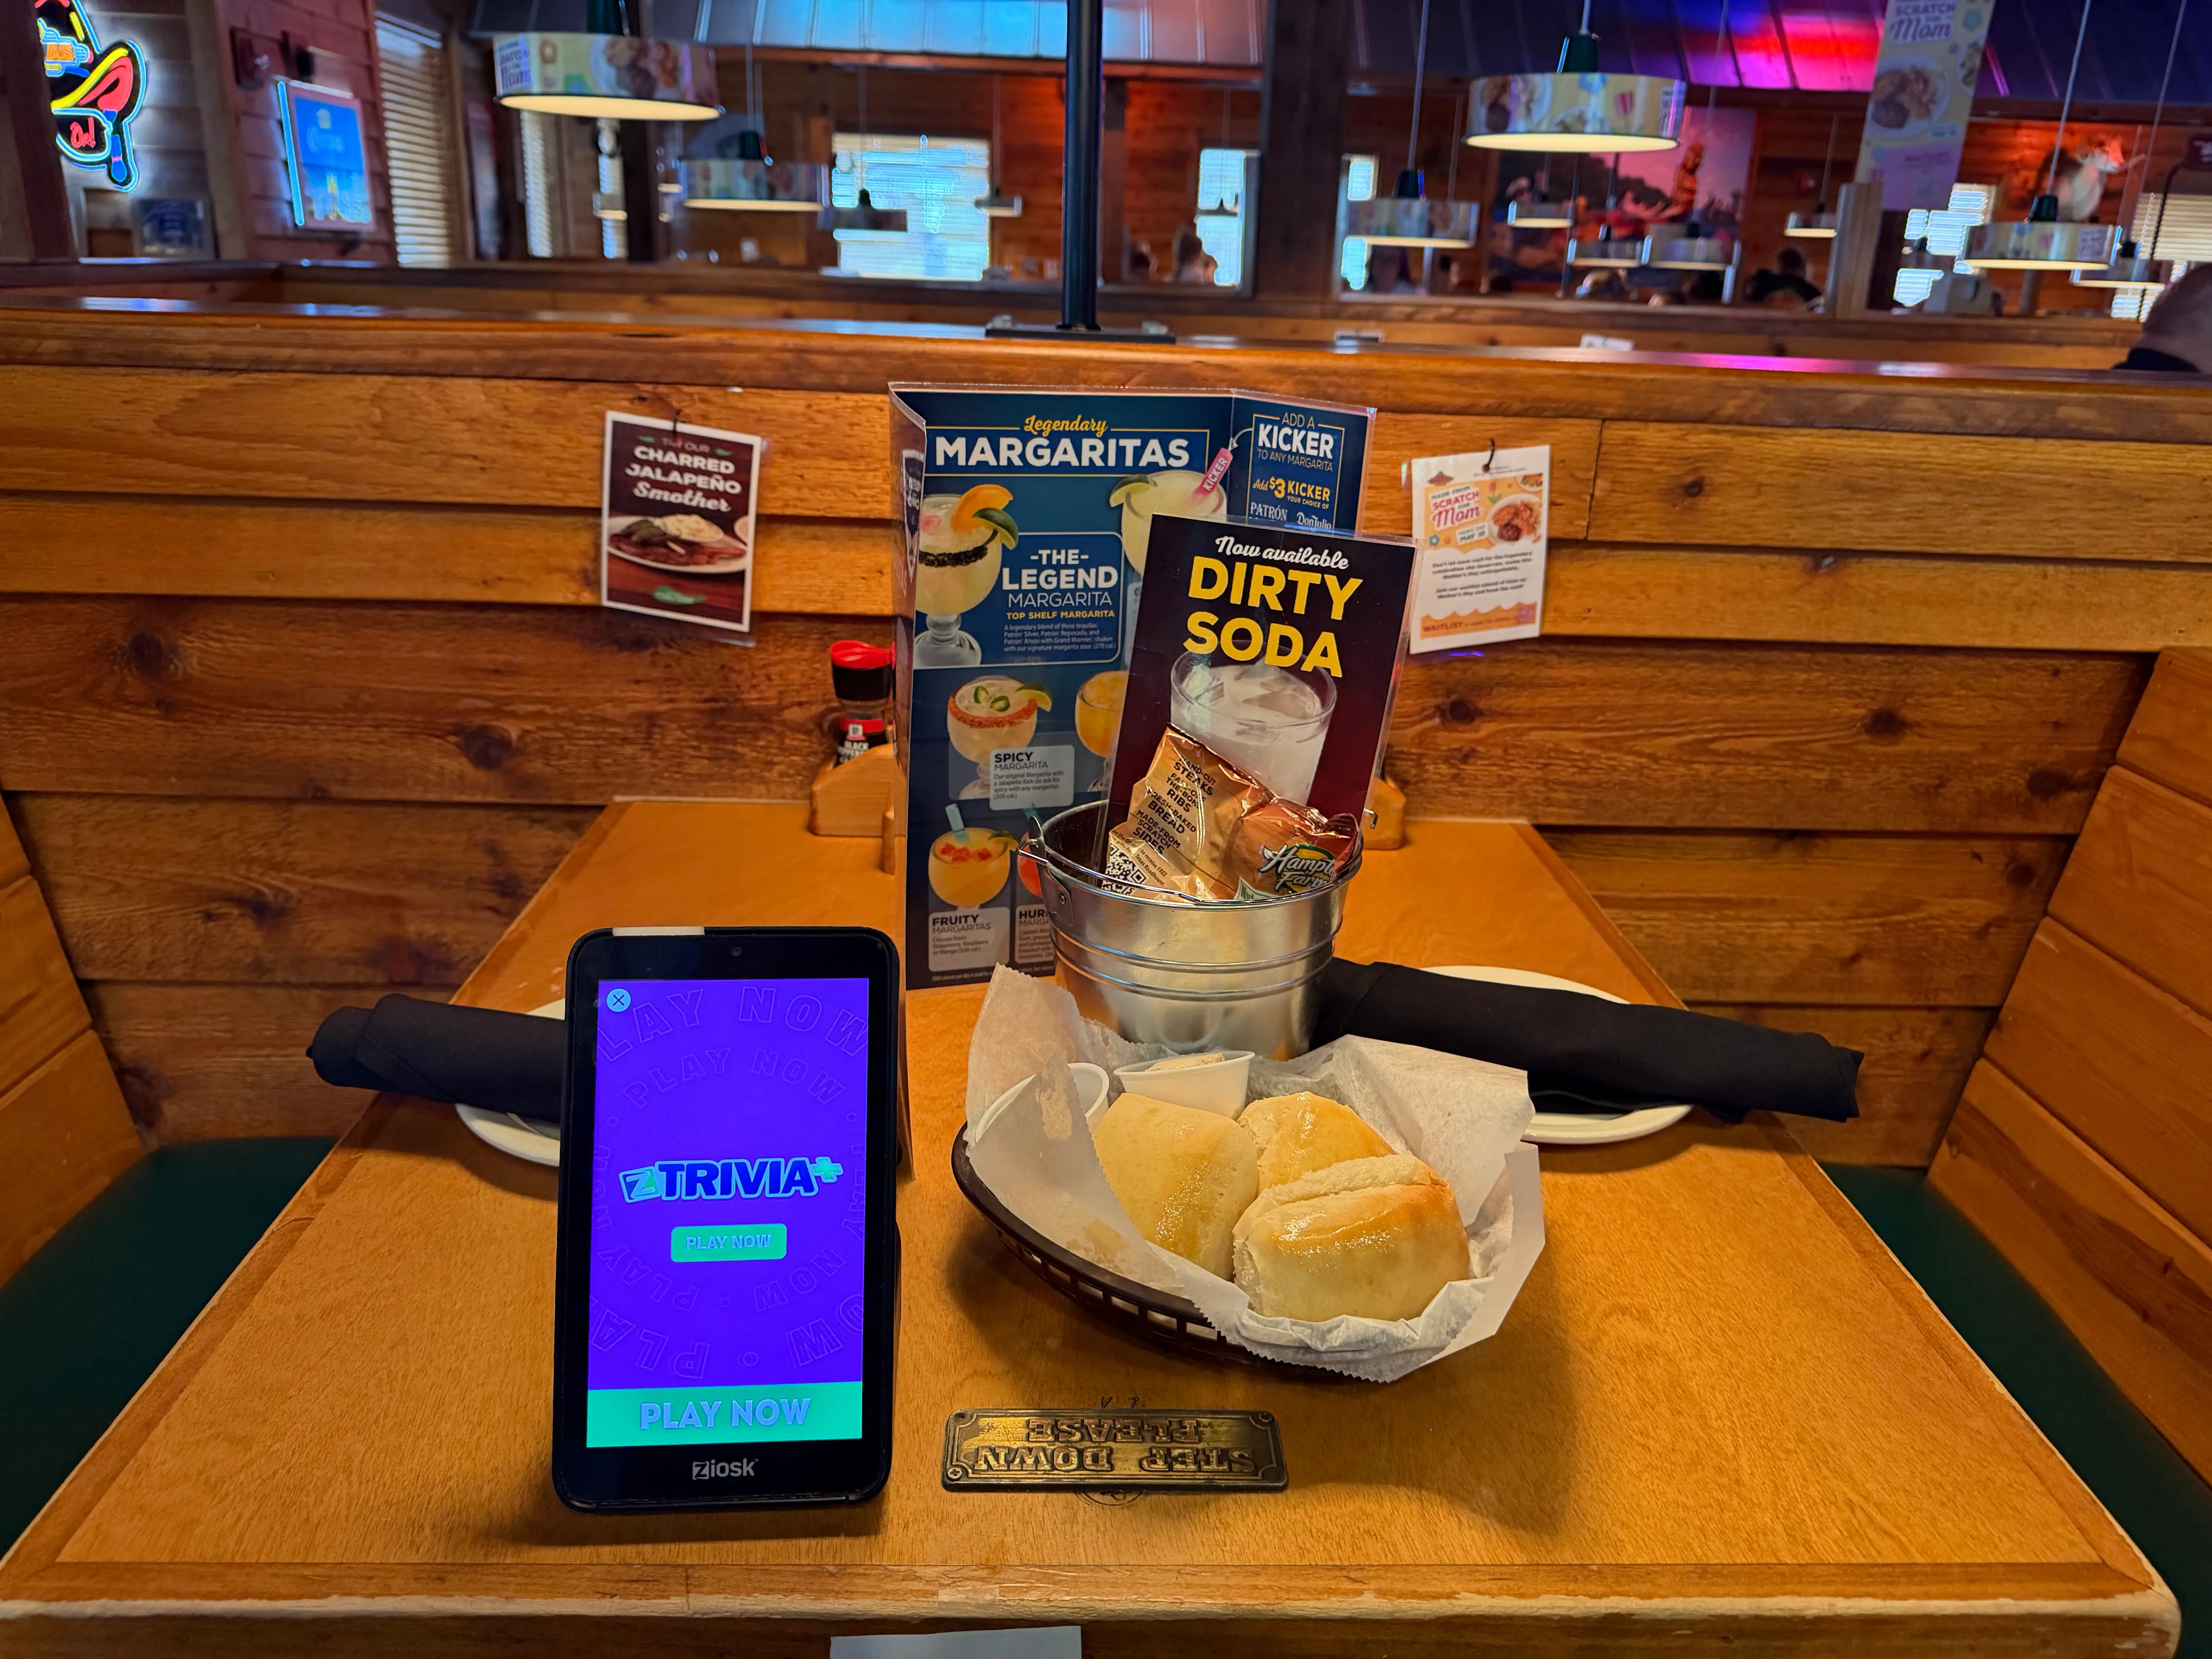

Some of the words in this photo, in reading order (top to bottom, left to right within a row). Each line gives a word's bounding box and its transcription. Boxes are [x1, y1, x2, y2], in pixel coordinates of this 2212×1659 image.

[1024, 414, 1108, 437] Legendary
[1281, 412, 1305, 427] ADD
[1307, 416, 1315, 429] A
[936, 436, 1190, 467] MARGARITAS
[1258, 423, 1333, 459] KICKER
[634, 445, 735, 474] CHARRED
[1257, 449, 1268, 460] TO
[1269, 452, 1287, 463] ANY
[1287, 455, 1333, 472] MARGARITA
[625, 464, 742, 494] JALAPEÑO
[1202, 457, 1228, 491] KICKER
[633, 481, 732, 512] Smother
[1252, 479, 1268, 491] Add
[1269, 476, 1285, 498] $3
[1287, 480, 1330, 501] KICKER
[1433, 491, 1479, 510] SCRATCH
[1250, 502, 1288, 521] PATRÓN
[1302, 499, 1320, 508] CHOICE
[1432, 507, 1481, 528] Mom
[1215, 536, 1261, 556] Now
[1262, 547, 1349, 570] available
[1002, 566, 1118, 590] LEGEND
[1188, 556, 1364, 620] DIRTY
[1008, 592, 1112, 608] MARGARITA
[1183, 611, 1343, 678] SODA
[994, 752, 1034, 763] SPICY
[994, 761, 1048, 771] MARGARITA
[1173, 762, 1214, 796] STEAKS
[1167, 788, 1192, 812] RIBS
[1137, 810, 1181, 848] MADE-FROM
[1148, 800, 1185, 834] BREAD
[1133, 827, 1164, 854] SIDES
[1138, 820, 1171, 849] SCRATCH
[1135, 854, 1146, 866] Texas
[1144, 864, 1164, 887] Roadhouse.
[1145, 853, 1158, 869] receive
[1157, 867, 1168, 877] FREE
[933, 914, 979, 926] FRUITY
[933, 922, 992, 934] MARGARITAS
[597, 988, 704, 1061] LAY
[738, 986, 868, 1056] NOW
[623, 1048, 731, 1108] PLAY
[750, 1048, 845, 1104] NOW
[686, 1236, 727, 1251] PLAY
[732, 1234, 772, 1249] NOW
[640, 1401, 721, 1430] PLAY
[731, 1398, 811, 1427] NOW
[1028, 1417, 1199, 1444] PLEASE
[973, 1445, 1112, 1472] DOWN
[1141, 1446, 1255, 1472] STEP
